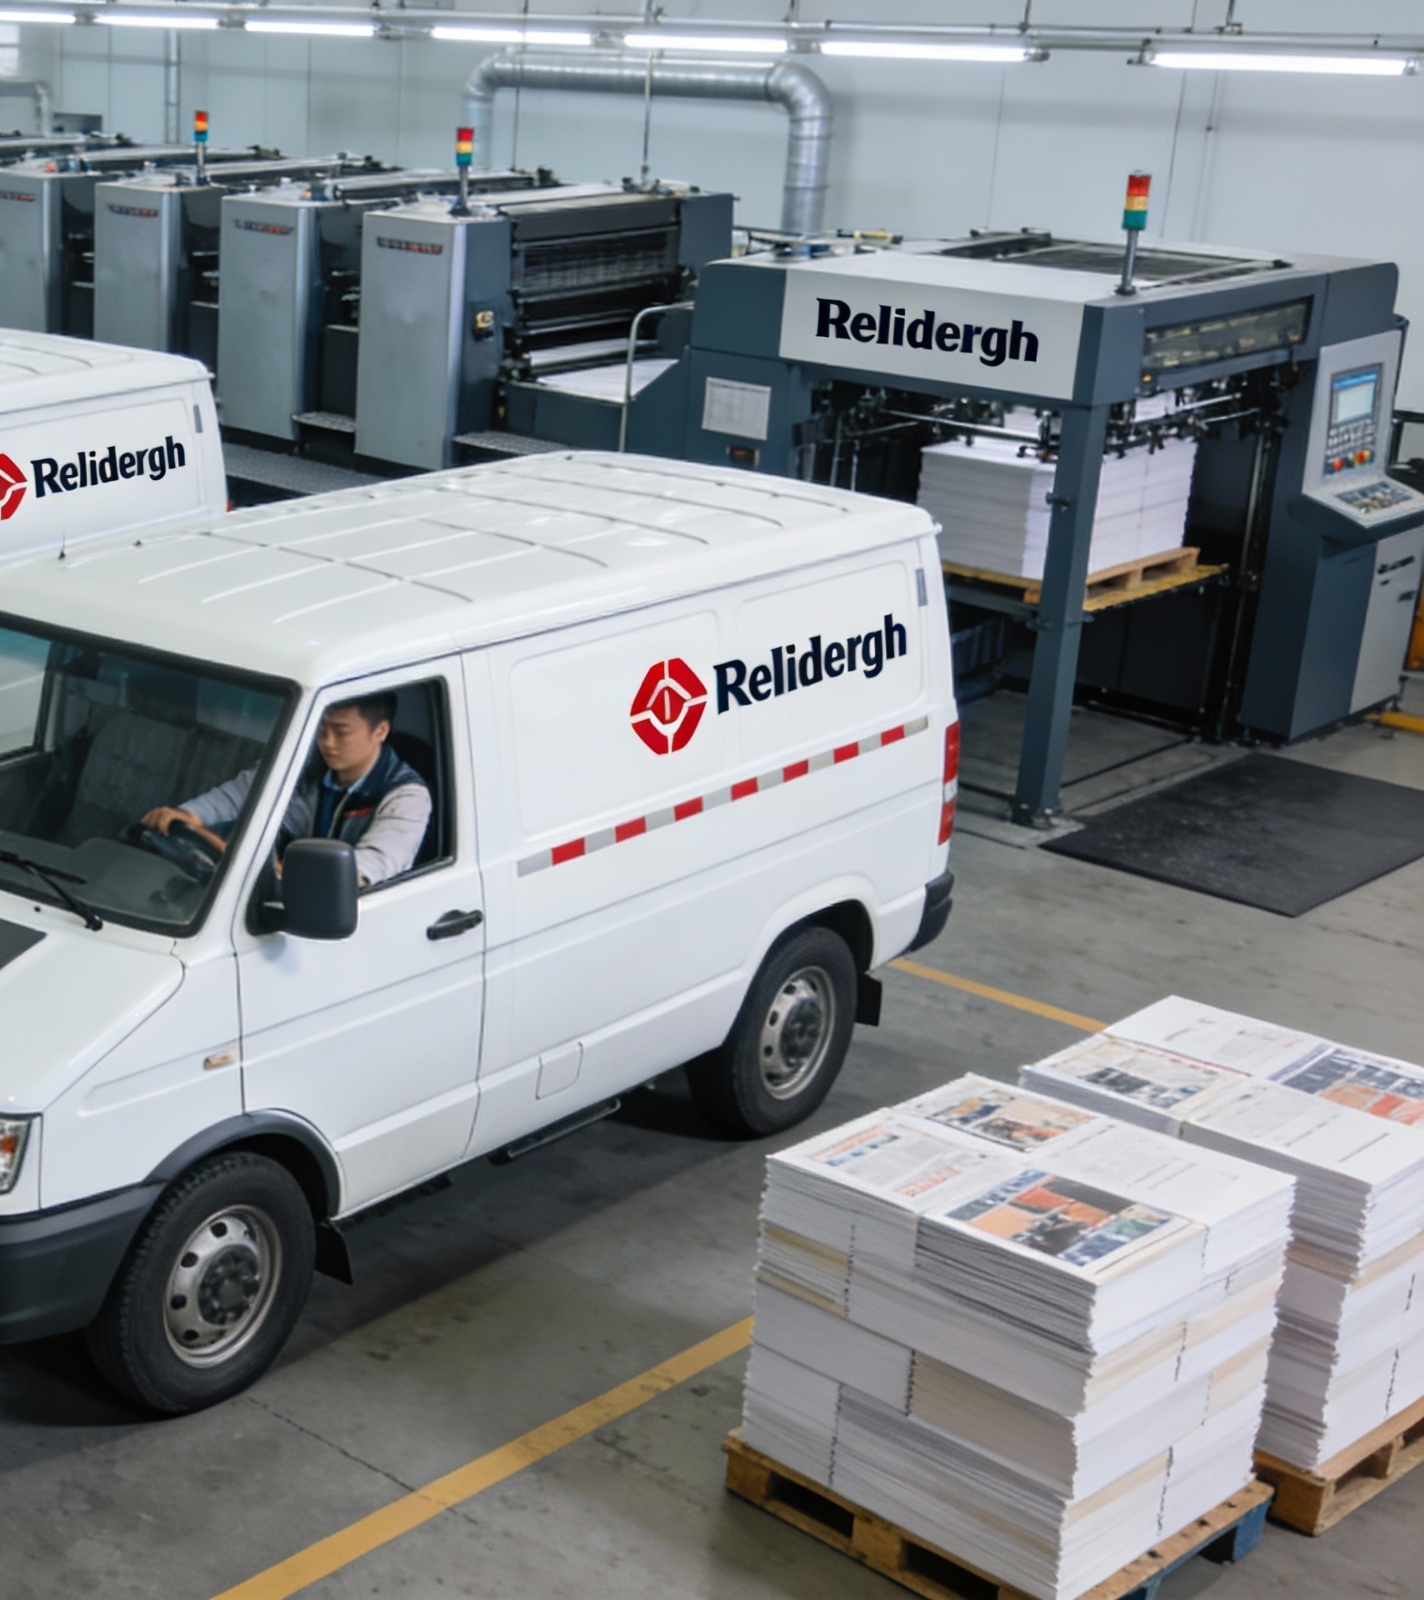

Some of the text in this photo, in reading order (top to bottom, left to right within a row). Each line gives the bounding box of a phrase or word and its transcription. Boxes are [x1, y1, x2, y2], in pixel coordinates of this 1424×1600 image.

[815, 298, 1039, 367] Relidergh
[30, 435, 186, 498] Relidergh
[713, 613, 907, 715] Relidergh
